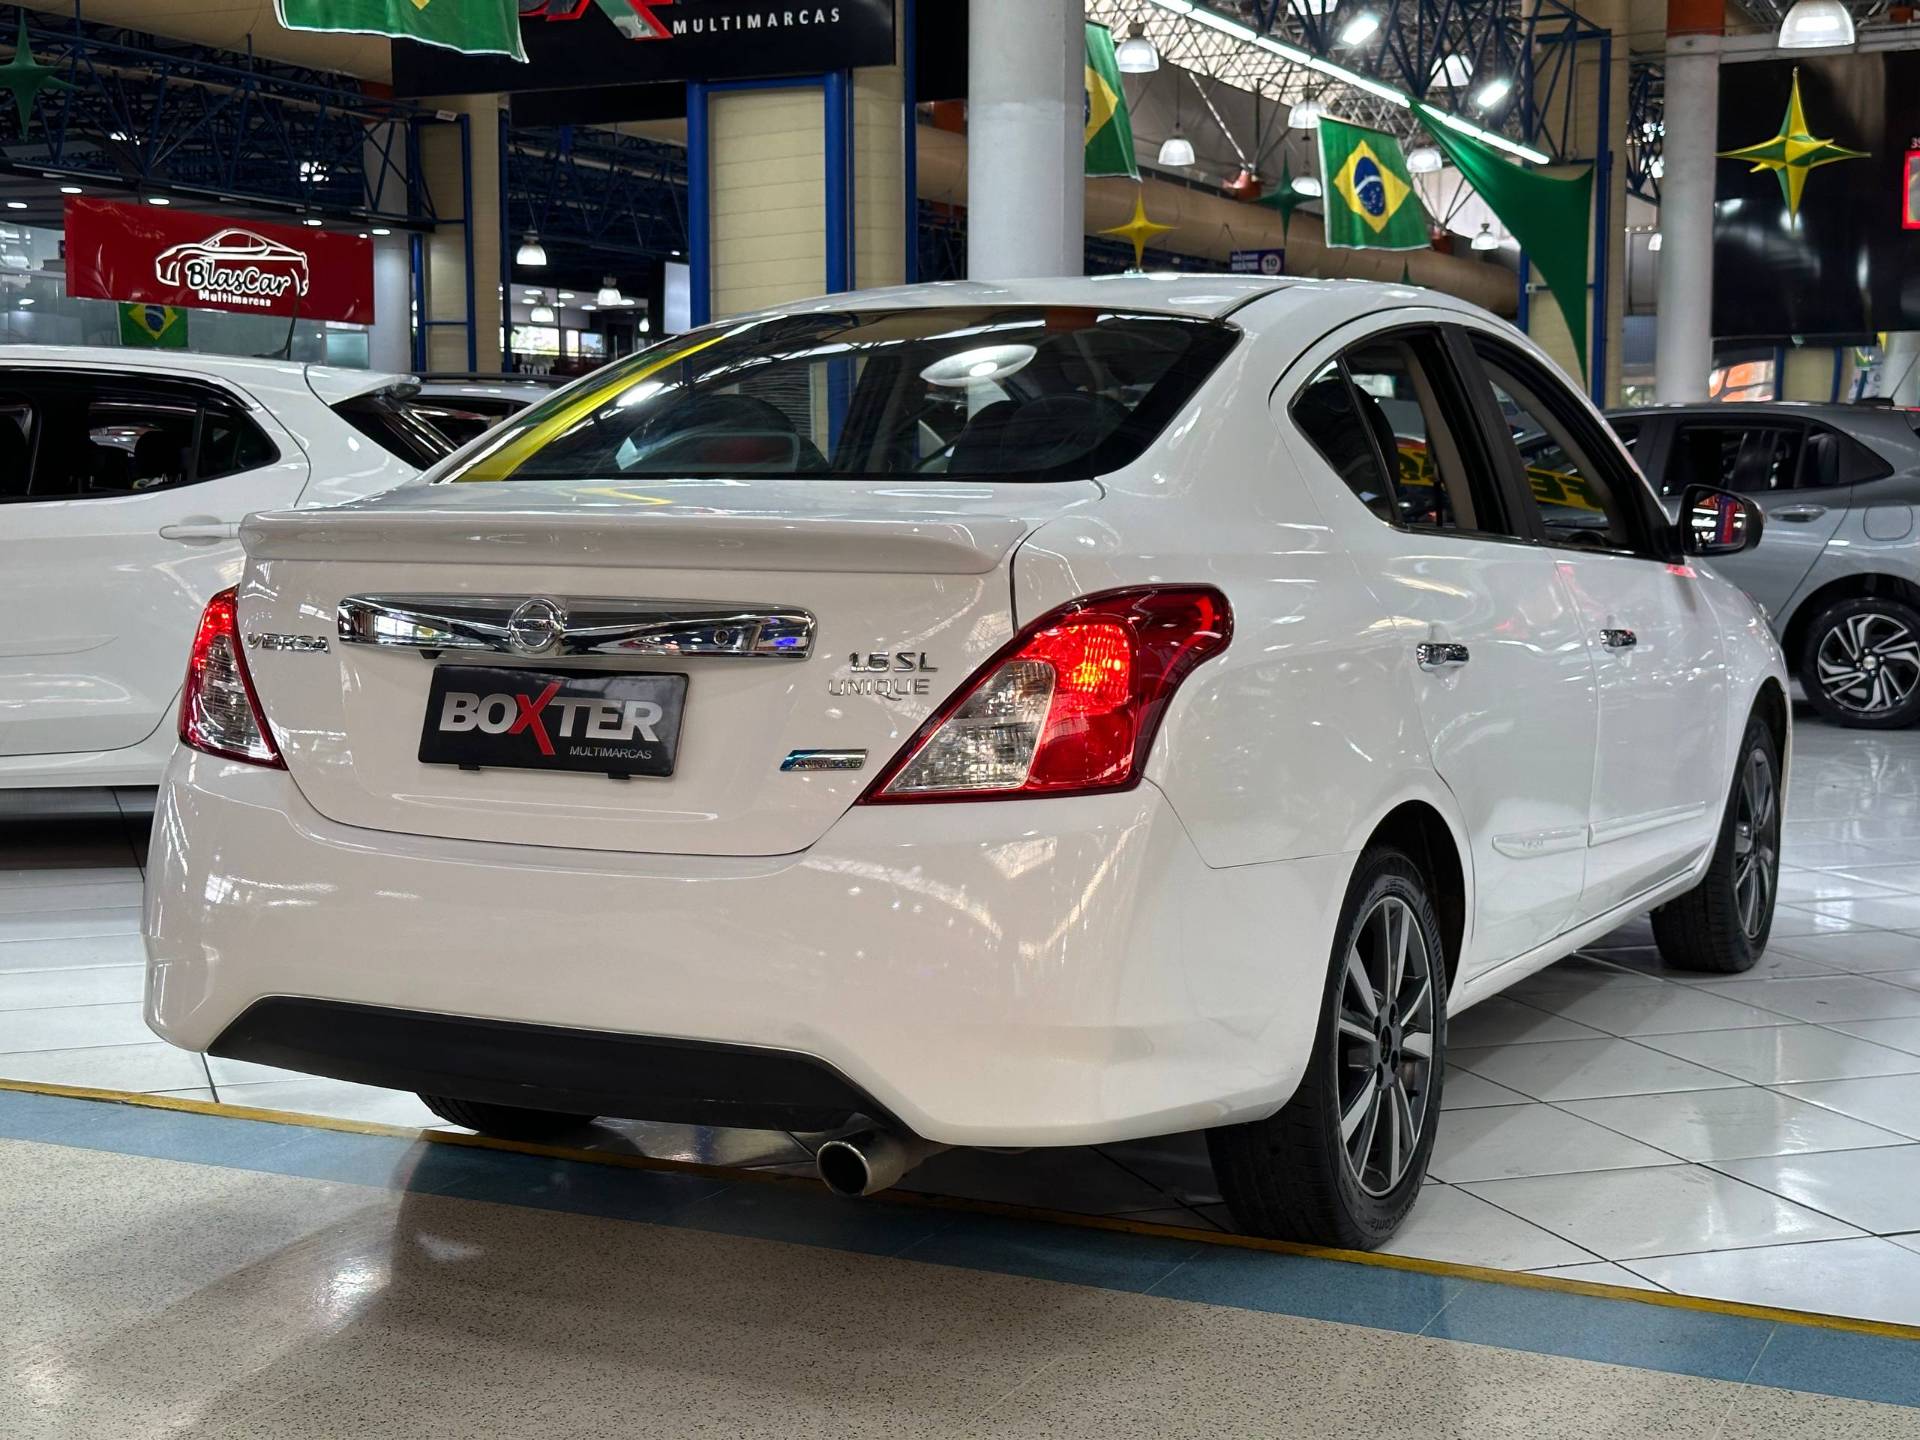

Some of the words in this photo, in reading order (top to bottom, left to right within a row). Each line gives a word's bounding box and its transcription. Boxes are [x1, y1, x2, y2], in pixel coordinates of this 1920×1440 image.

[672, 8, 840, 34] MULTIMARCAS
[185, 257, 291, 297] BlasCar
[199, 289, 271, 307] Multimarcas
[247, 632, 331, 654] VERSA
[828, 679, 931, 701] UNIQUE
[439, 680, 661, 757] BOXTER
[569, 745, 653, 760] MULTIMARCAS
